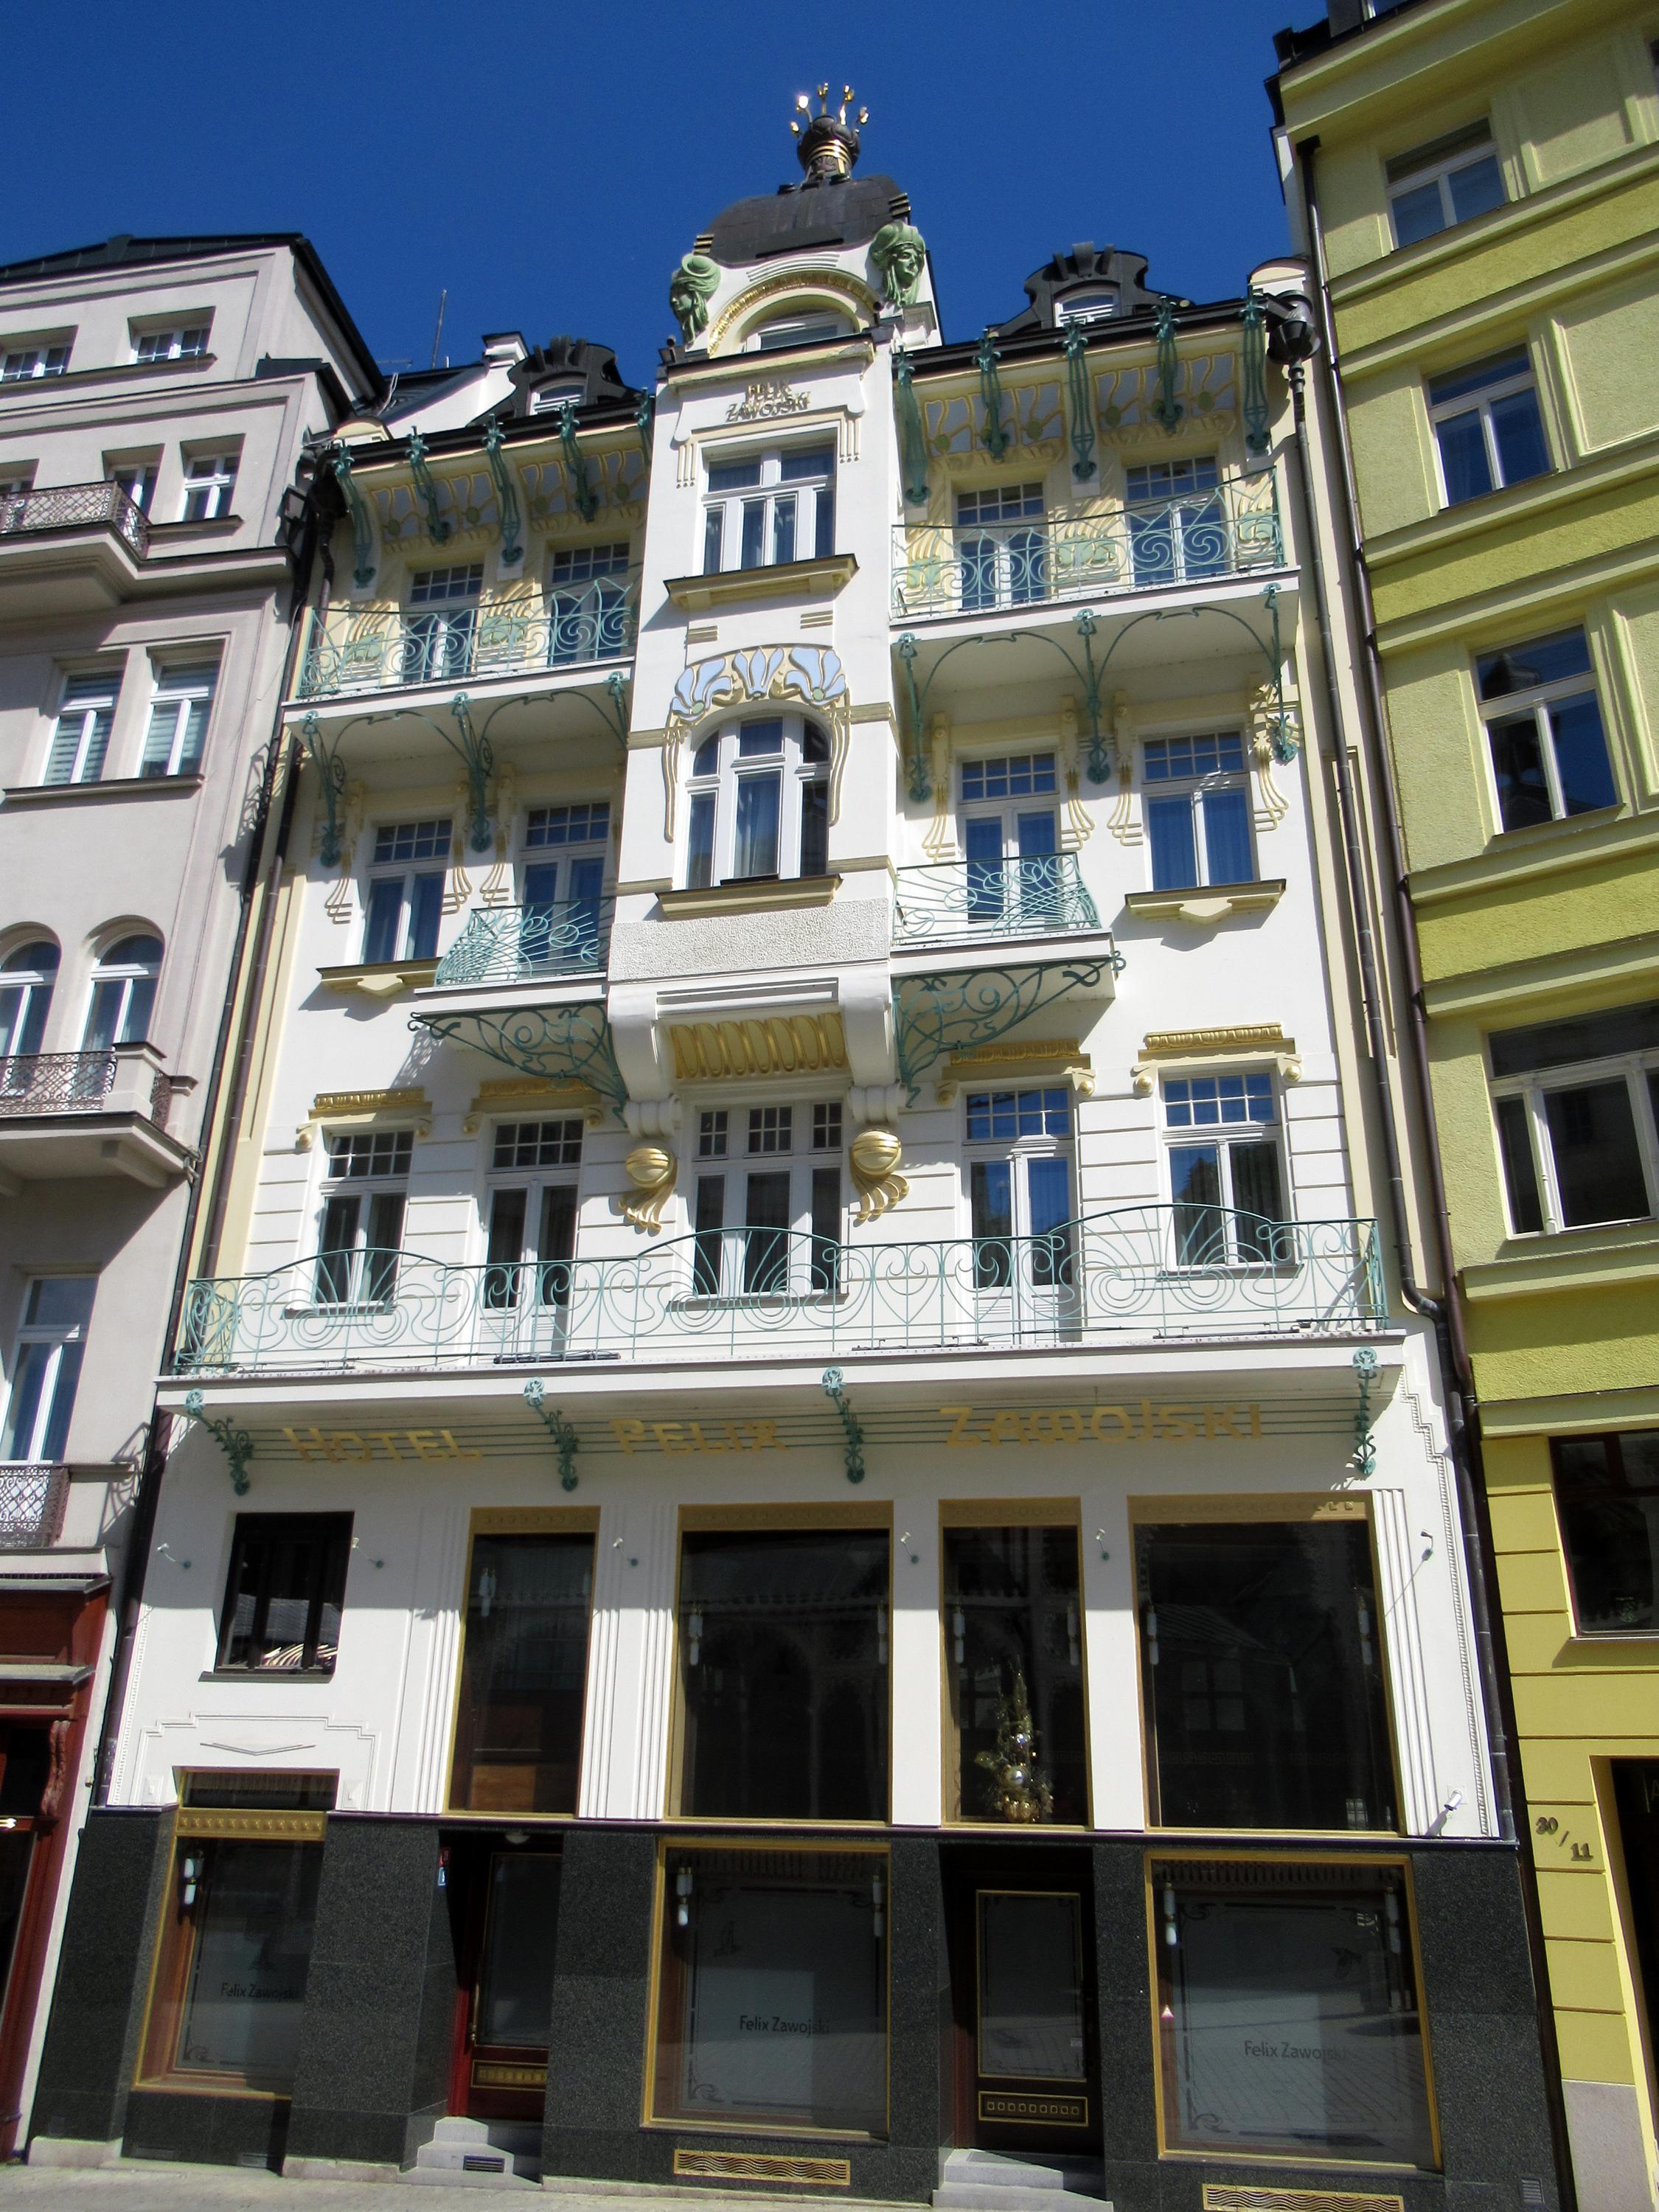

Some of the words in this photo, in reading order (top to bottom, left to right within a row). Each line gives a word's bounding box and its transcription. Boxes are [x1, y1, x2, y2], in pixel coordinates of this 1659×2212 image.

[745, 378, 792, 403] FELIX
[726, 391, 811, 421] ZAWOJSKI
[282, 1427, 484, 1465] HOTEL
[608, 1417, 791, 1457] FELIX
[939, 1399, 1263, 1448] ZAWOJSKI
[220, 1982, 246, 1997] Felix
[740, 2015, 769, 2031] Felix
[772, 2017, 830, 2039] Zawojski
[1244, 2039, 1279, 2058] Felix
